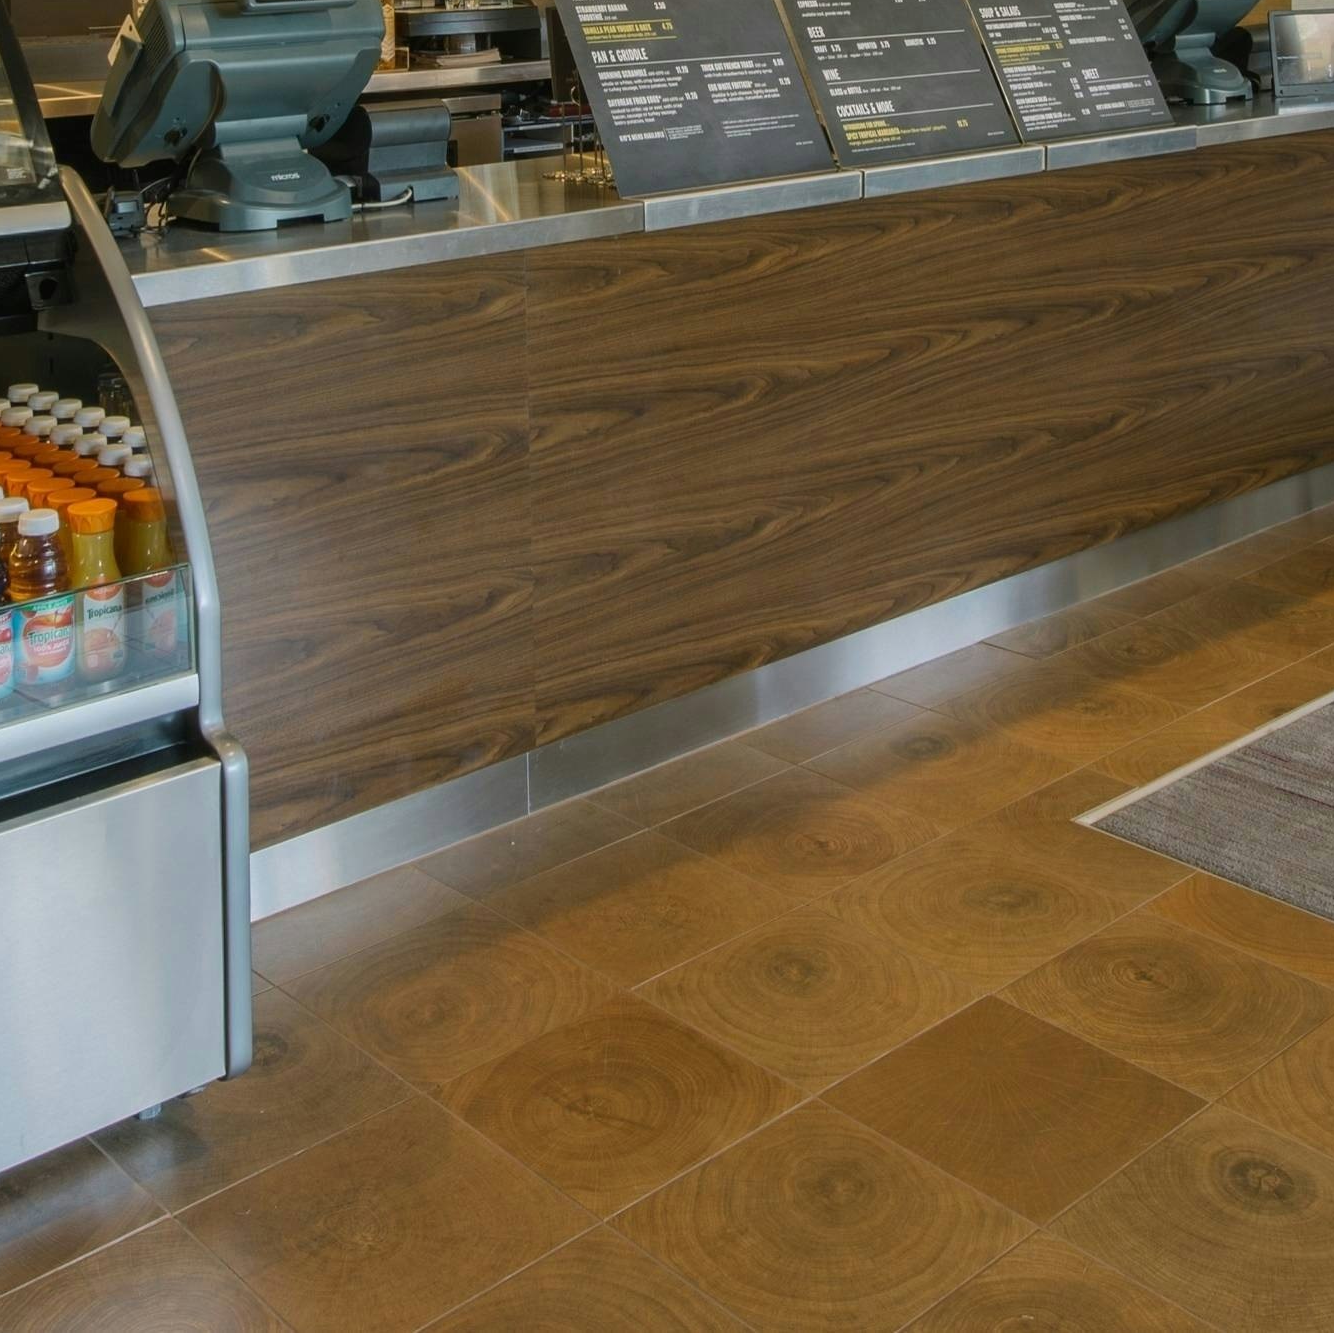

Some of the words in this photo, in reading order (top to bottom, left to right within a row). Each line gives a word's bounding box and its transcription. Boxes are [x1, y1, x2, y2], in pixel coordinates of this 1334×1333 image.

[979, 7, 995, 19] SOUP
[999, 5, 1022, 17] SALADS
[807, 26, 826, 39] BEER
[591, 51, 608, 64] PAN
[616, 47, 649, 62] GRIDDLE
[822, 68, 842, 81] WINE
[836, 102, 871, 118] COCKTAILS
[876, 100, 895, 113] MORE
[271, 171, 300, 182] micros
[87, 605, 123, 620] Tropicana
[28, 627, 71, 647] Tropican
